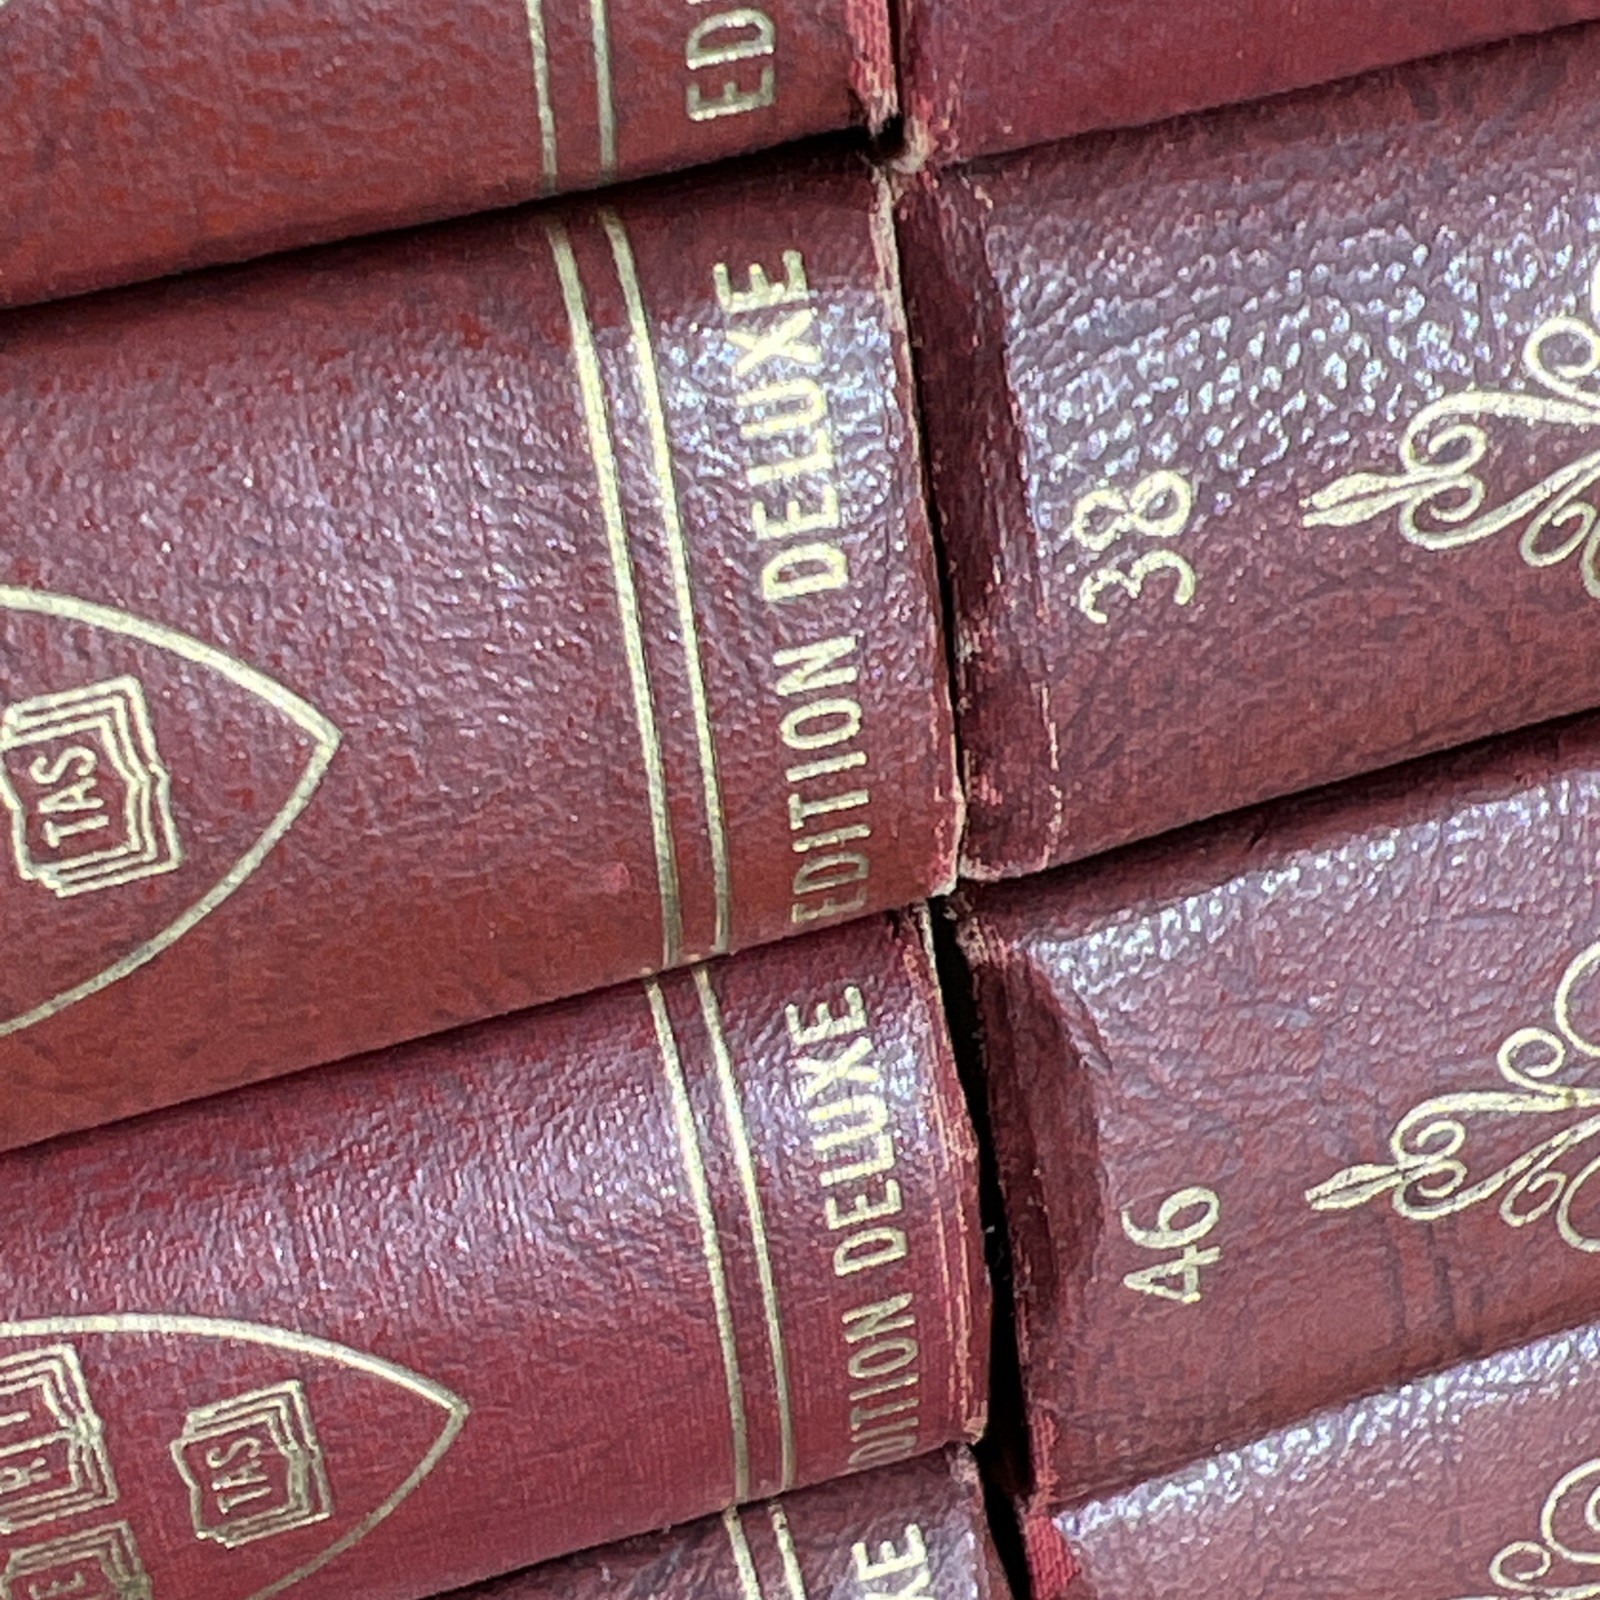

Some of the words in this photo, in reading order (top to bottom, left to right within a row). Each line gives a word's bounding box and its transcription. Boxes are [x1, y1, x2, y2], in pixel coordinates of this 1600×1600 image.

[686, 0, 776, 121] ED
[713, 250, 848, 601] DELUXE
[1072, 469, 1196, 624] 38
[29, 746, 110, 847] TAS
[773, 635, 871, 923] EDITION
[785, 986, 908, 1277] DELUXE
[1121, 1186, 1222, 1304] 46
[842, 1292, 920, 1466] DITION
[206, 1437, 273, 1514] TAS
